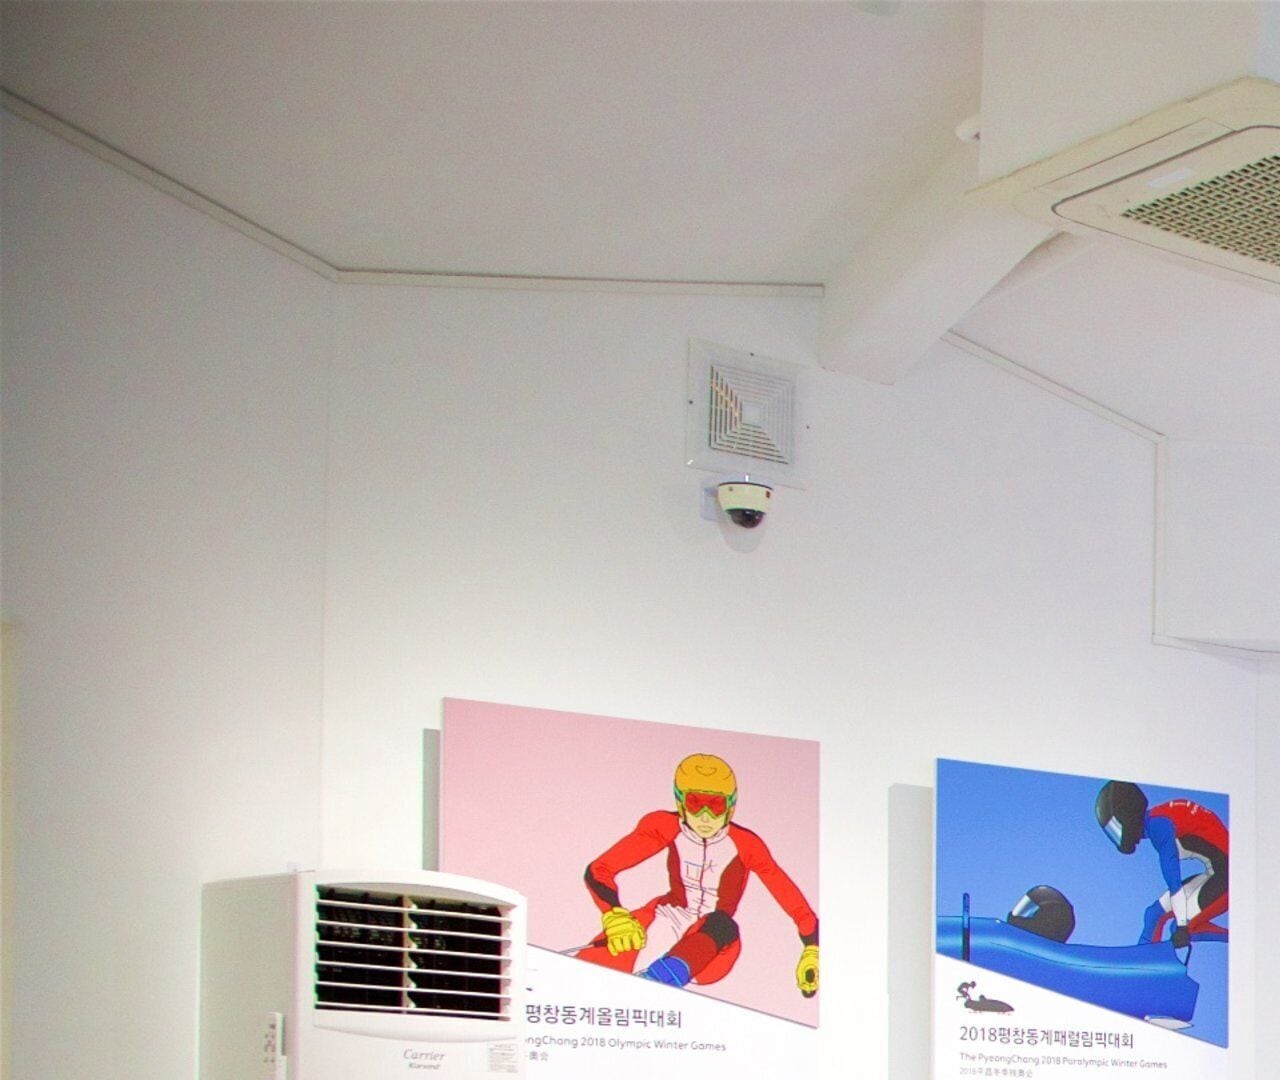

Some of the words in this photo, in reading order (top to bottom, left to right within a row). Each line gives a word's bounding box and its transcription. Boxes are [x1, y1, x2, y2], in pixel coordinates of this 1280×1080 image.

[525, 1035, 578, 1048] ngChang
[581, 1037, 606, 1047] 2018
[608, 1037, 651, 1050] Olympic
[653, 1039, 689, 1050] Winter
[690, 1040, 726, 1052] Games
[959, 1026, 1134, 1049] 2018평창동계패럴림픽대회
[403, 1048, 445, 1061] Carrier
[960, 1052, 977, 1061] The
[978, 1053, 1040, 1066] PyeongChang
[1041, 1056, 1061, 1065] 2018
[1063, 1057, 1109, 1068] Paralympic
[1111, 1059, 1138, 1068] Winter
[1140, 1060, 1168, 1069] Games
